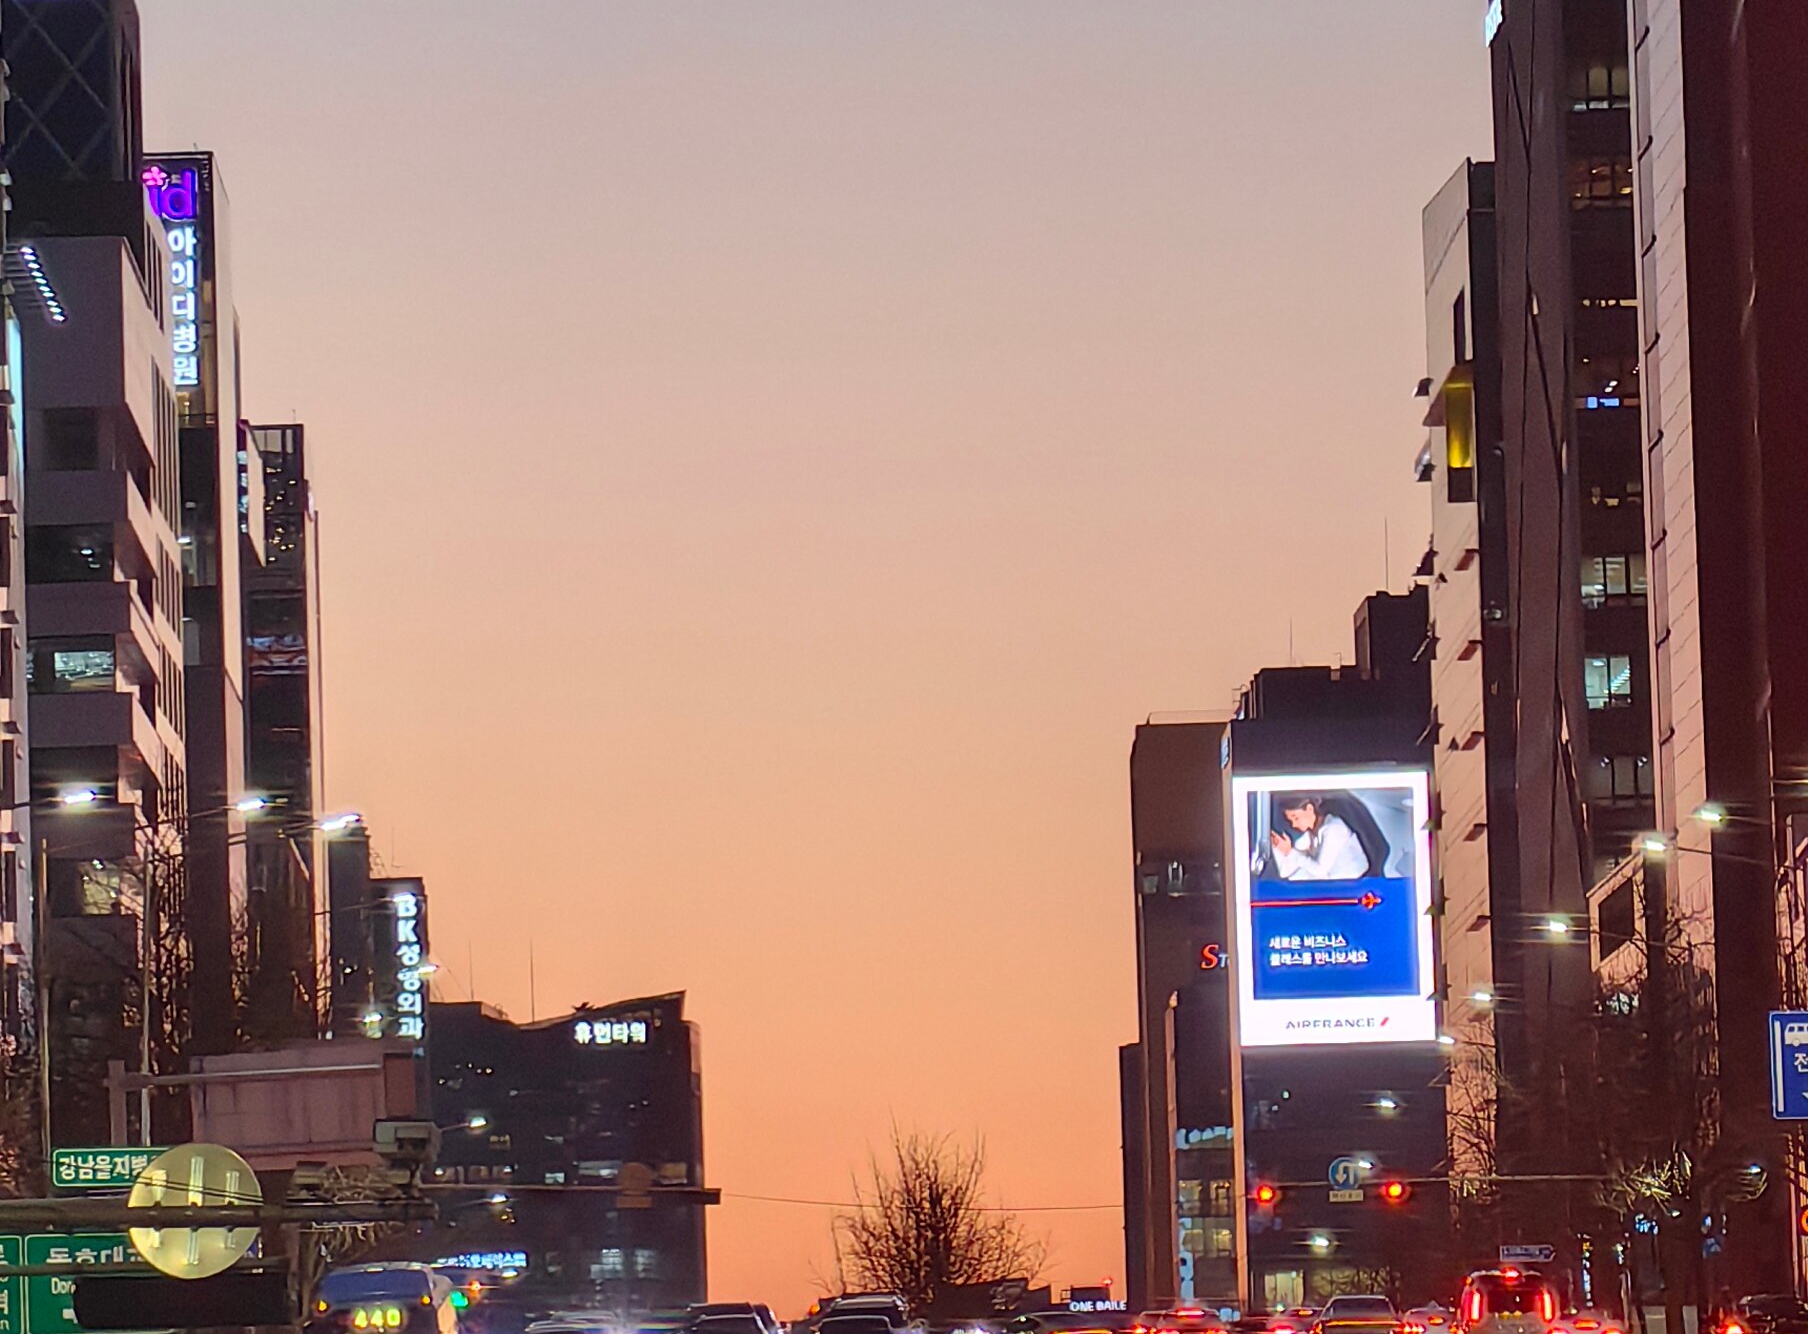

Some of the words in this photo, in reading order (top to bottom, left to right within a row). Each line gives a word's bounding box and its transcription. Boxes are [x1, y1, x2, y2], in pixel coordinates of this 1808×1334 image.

[167, 228, 198, 385] 아이디병원
[1269, 934, 1302, 950] 새로운
[1303, 932, 1347, 948] 비즈니스
[394, 892, 424, 1040] BK성형외과
[1314, 949, 1368, 965] 만나보세요
[59, 1154, 156, 1180] 강남을지병
[1069, 1301, 1094, 1312] ONE
[354, 1308, 401, 1328] 440
